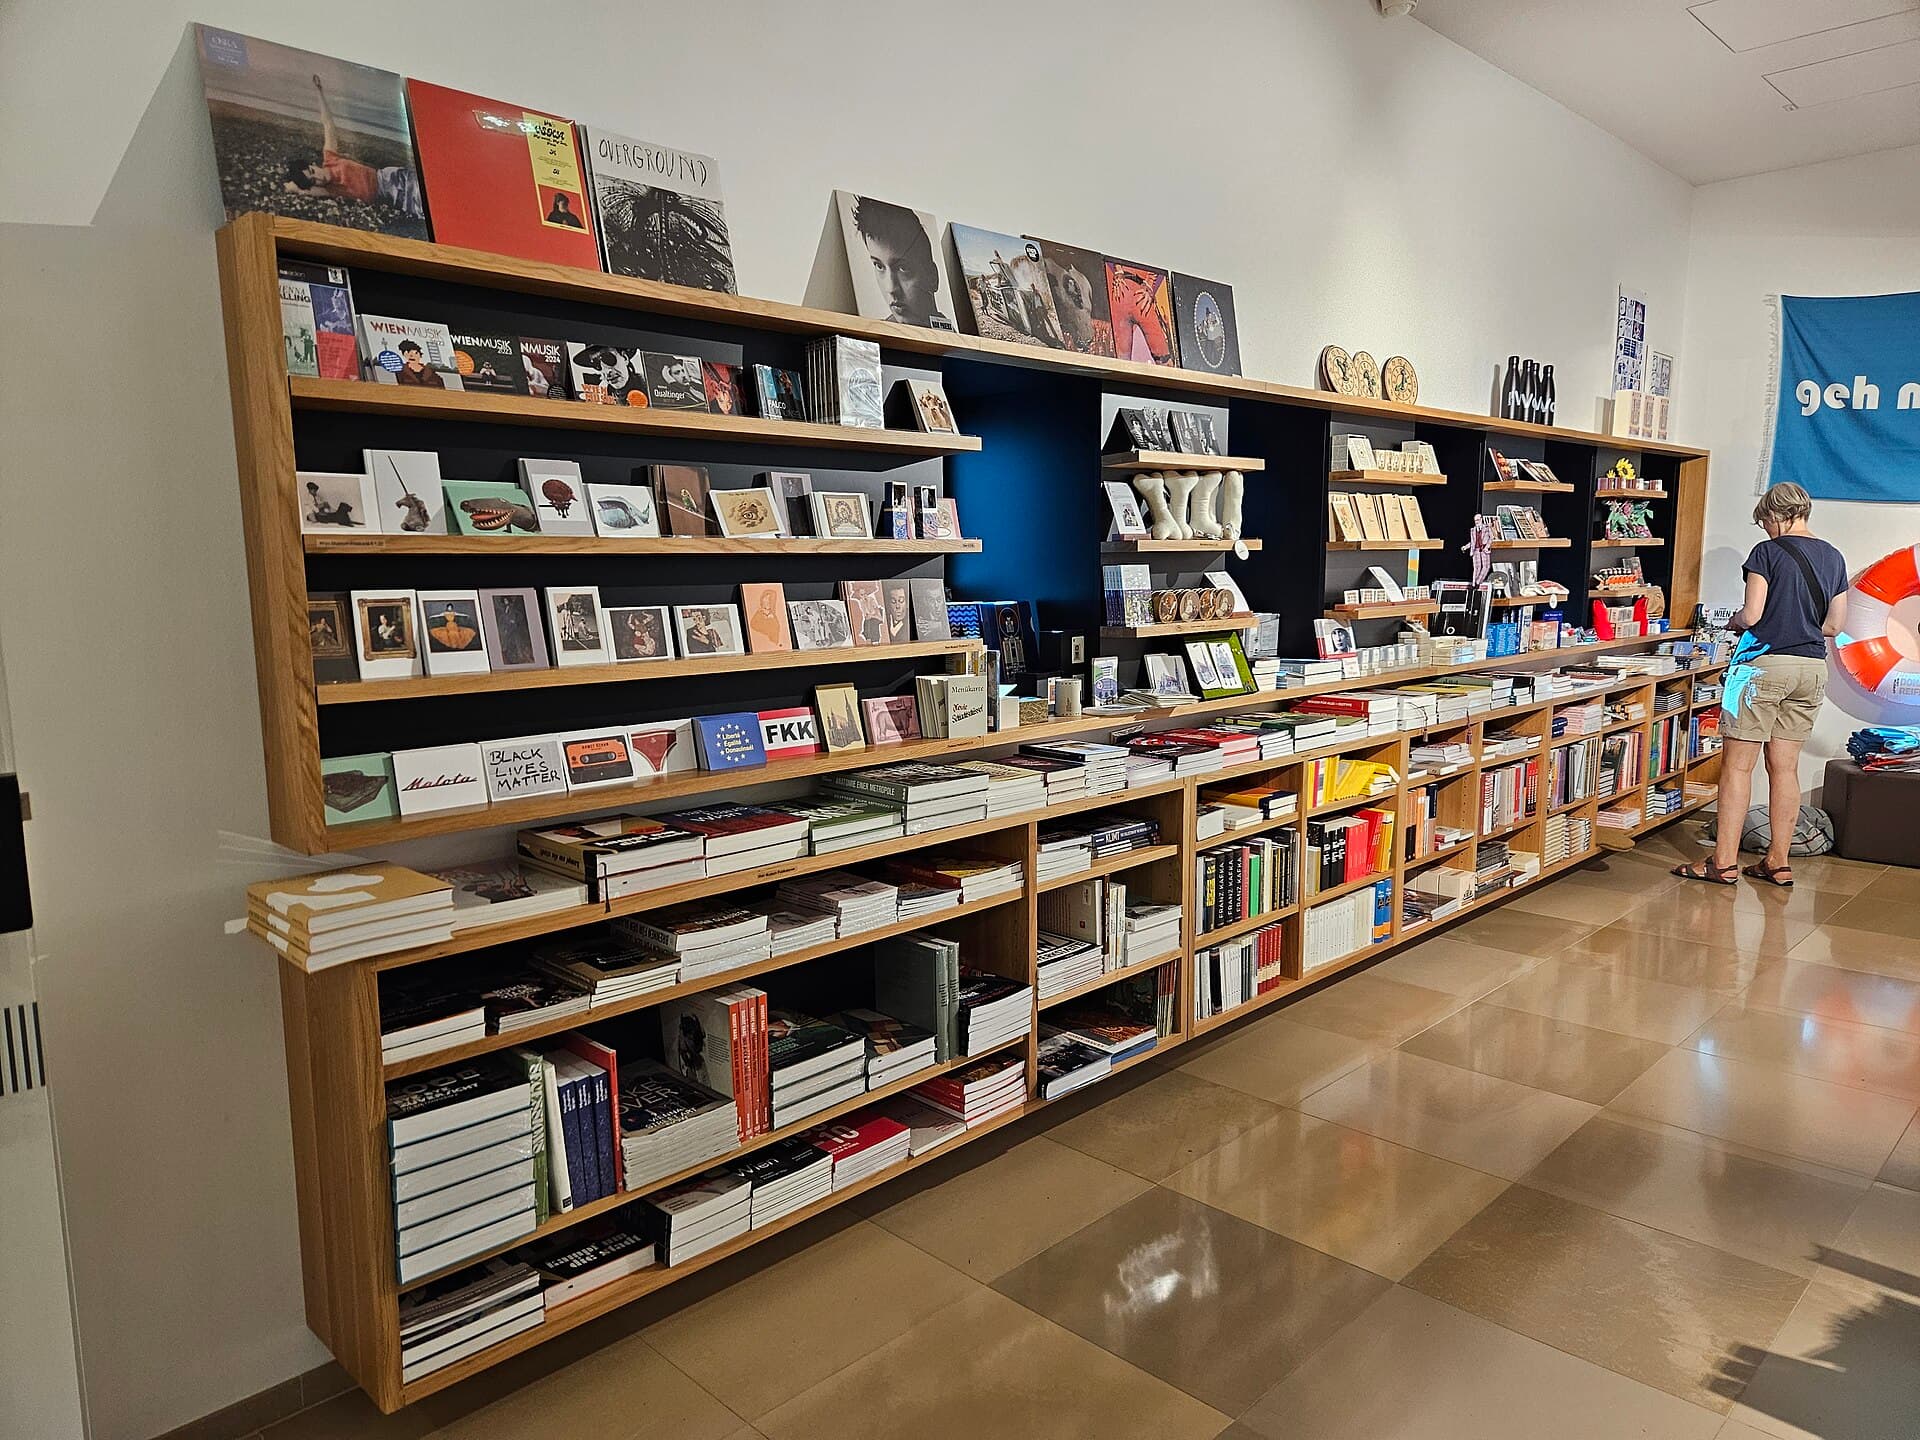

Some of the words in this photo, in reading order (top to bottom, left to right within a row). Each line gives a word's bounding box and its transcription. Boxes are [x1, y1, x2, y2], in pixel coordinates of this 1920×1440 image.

[599, 139, 707, 187] OVERGROUND
[370, 321, 442, 340] WIENMUSIK
[450, 334, 511, 351] WIENMUSIK
[520, 342, 561, 356] NMUSIK
[1795, 375, 1880, 416] geh
[765, 721, 815, 744] FKK
[489, 748, 544, 765] BLACK
[495, 761, 549, 777] LIVES
[497, 770, 561, 792] MATTER
[736, 1158, 780, 1178] Wien
